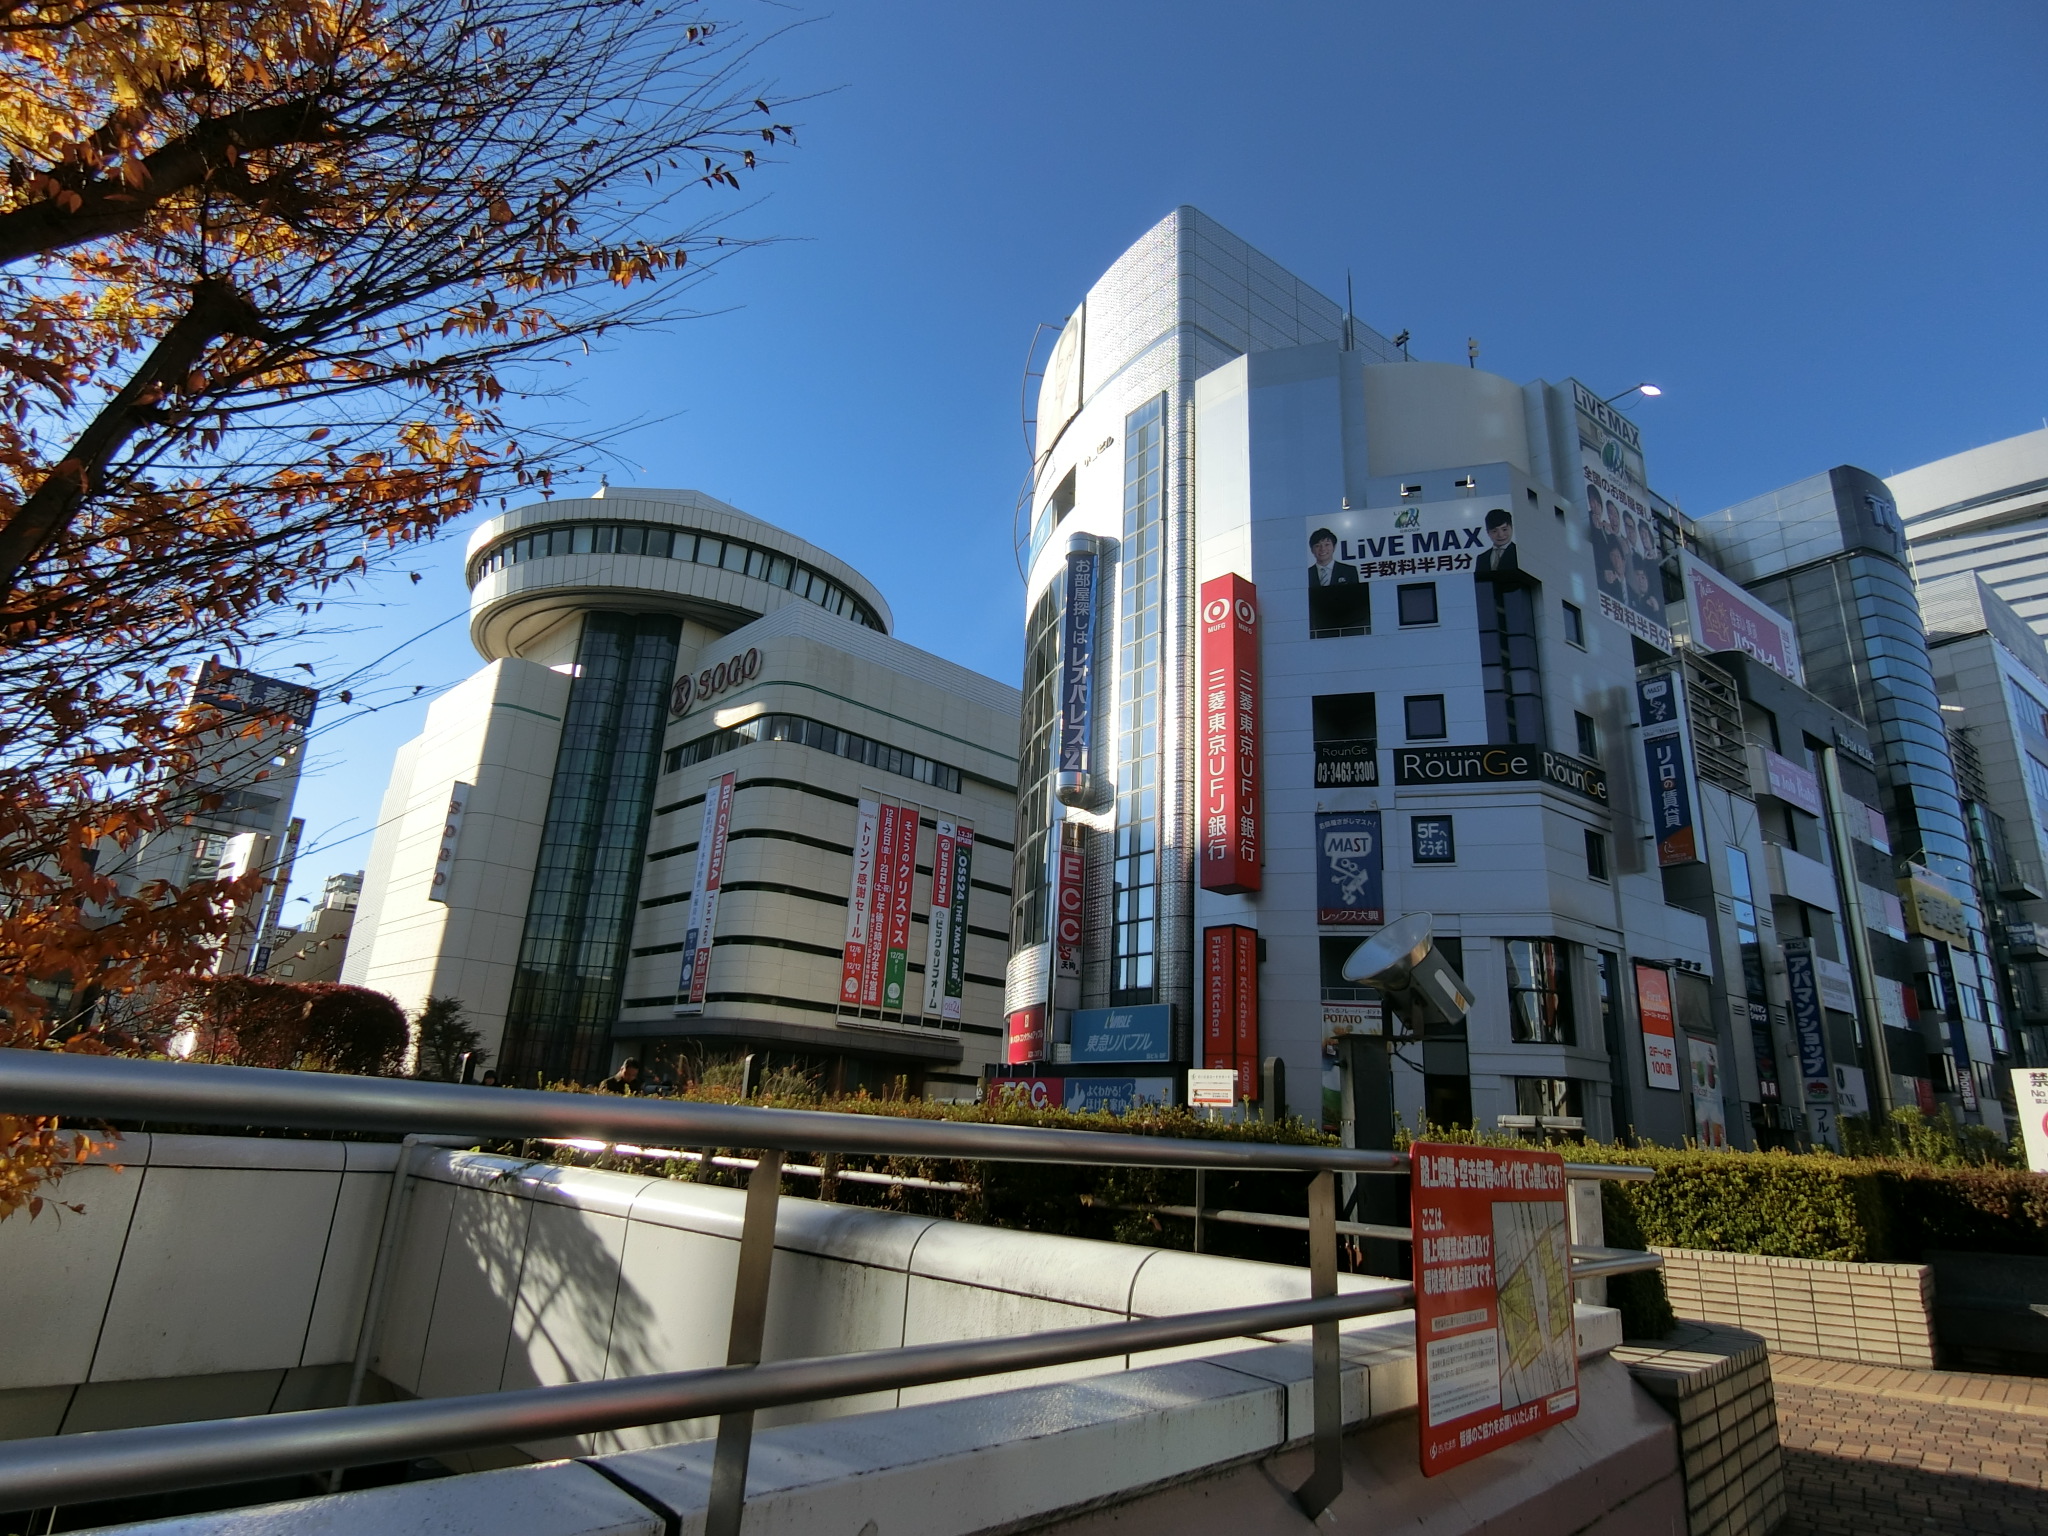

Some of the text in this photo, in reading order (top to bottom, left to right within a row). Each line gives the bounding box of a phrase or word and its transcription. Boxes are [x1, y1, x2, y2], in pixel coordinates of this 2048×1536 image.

[1573, 382, 1606, 424] LiVE
[1607, 409, 1641, 451] MAX
[1341, 527, 1485, 561] LiVE MAX
[1360, 553, 1473, 578] 手数料半月分
[1207, 622, 1226, 633] MUFG
[1238, 622, 1253, 635] MUFG
[1600, 595, 1670, 650] 手数料半月分
[697, 648, 761, 700] SOGO
[1647, 686, 1663, 695] MAST
[1208, 668, 1227, 861] 三菱東京UFJ銀行
[1239, 668, 1255, 863] 三菱東京UFJ銀行
[1323, 745, 1368, 757] RounGe
[1403, 750, 1528, 779] RounGe
[1317, 760, 1375, 783] 03-3463-3300
[1543, 752, 1607, 798] RounGe
[1657, 745, 1682, 829] リロの賃貸
[710, 784, 731, 881] BIC CAMERA
[1319, 818, 1377, 829] お部屋さがしマスト!
[1417, 822, 1447, 839] 5Fへ
[433, 801, 462, 886] SOGO
[1327, 838, 1369, 852] MAST
[1418, 840, 1448, 856] どうぞ!
[852, 822, 871, 938] トリンプ感謝セール
[893, 821, 912, 944] そごうのクリスマス
[1060, 856, 1081, 942] ECC
[951, 856, 968, 980] OSS24 THE XMAS FAIR
[1321, 910, 1379, 921] レックス大興
[697, 951, 708, 965] 3F
[929, 919, 944, 1009] ビックのリフォーム
[1240, 936, 1248, 972] First
[1212, 935, 1222, 1037] First Kitchen
[1323, 1014, 1362, 1024] POTATO
[1789, 957, 1825, 1074] アパマンショップ
[1084, 1033, 1153, 1052] 東急リバブル
[1086, 1085, 1121, 1098] よくわかる!
[2031, 1089, 2046, 1097] No
[1422, 1208, 1446, 1231] ここは、
[1422, 1235, 1490, 1264] 路上喫煙禁止区域及び
